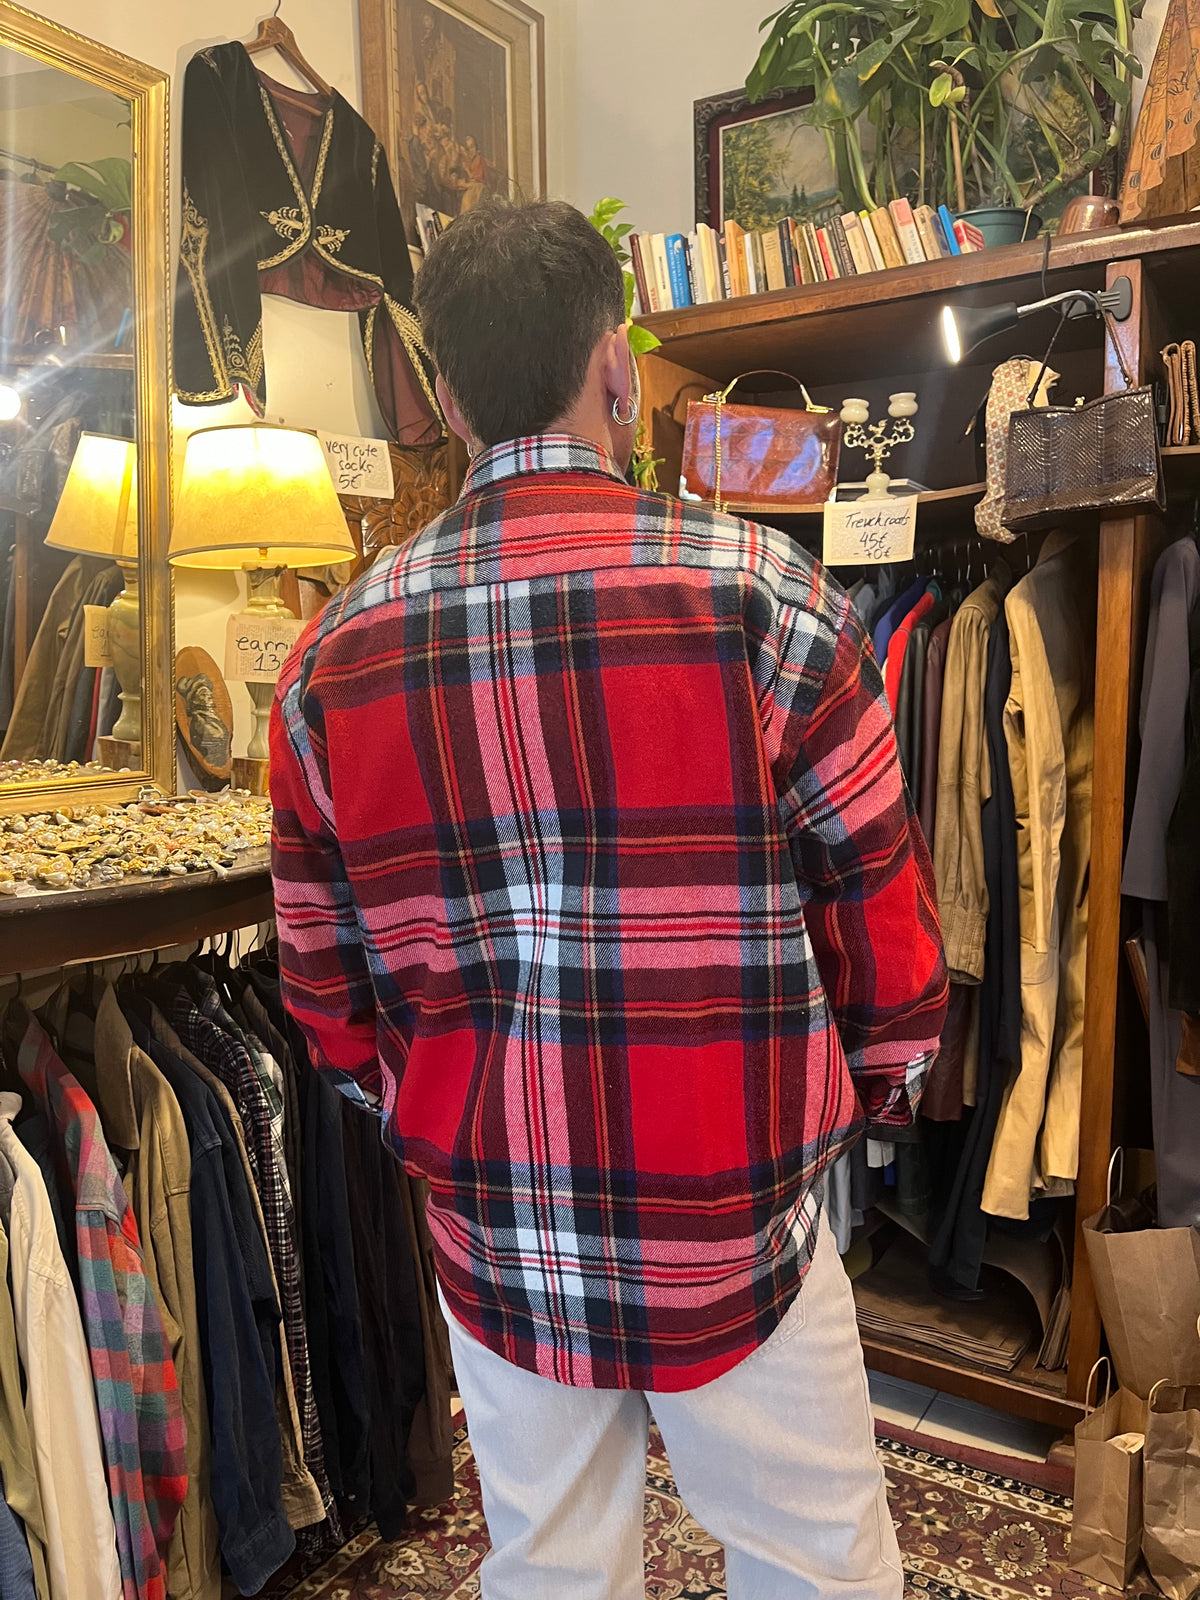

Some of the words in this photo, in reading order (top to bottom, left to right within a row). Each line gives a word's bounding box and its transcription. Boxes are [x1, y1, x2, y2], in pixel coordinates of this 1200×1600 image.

[723, 272, 731, 289] THIRD
[353, 444, 378, 457] cute
[339, 457, 374, 473] socks
[338, 473, 363, 490] 5€
[859, 532, 888, 550] 45€
[253, 653, 286, 672] 13
